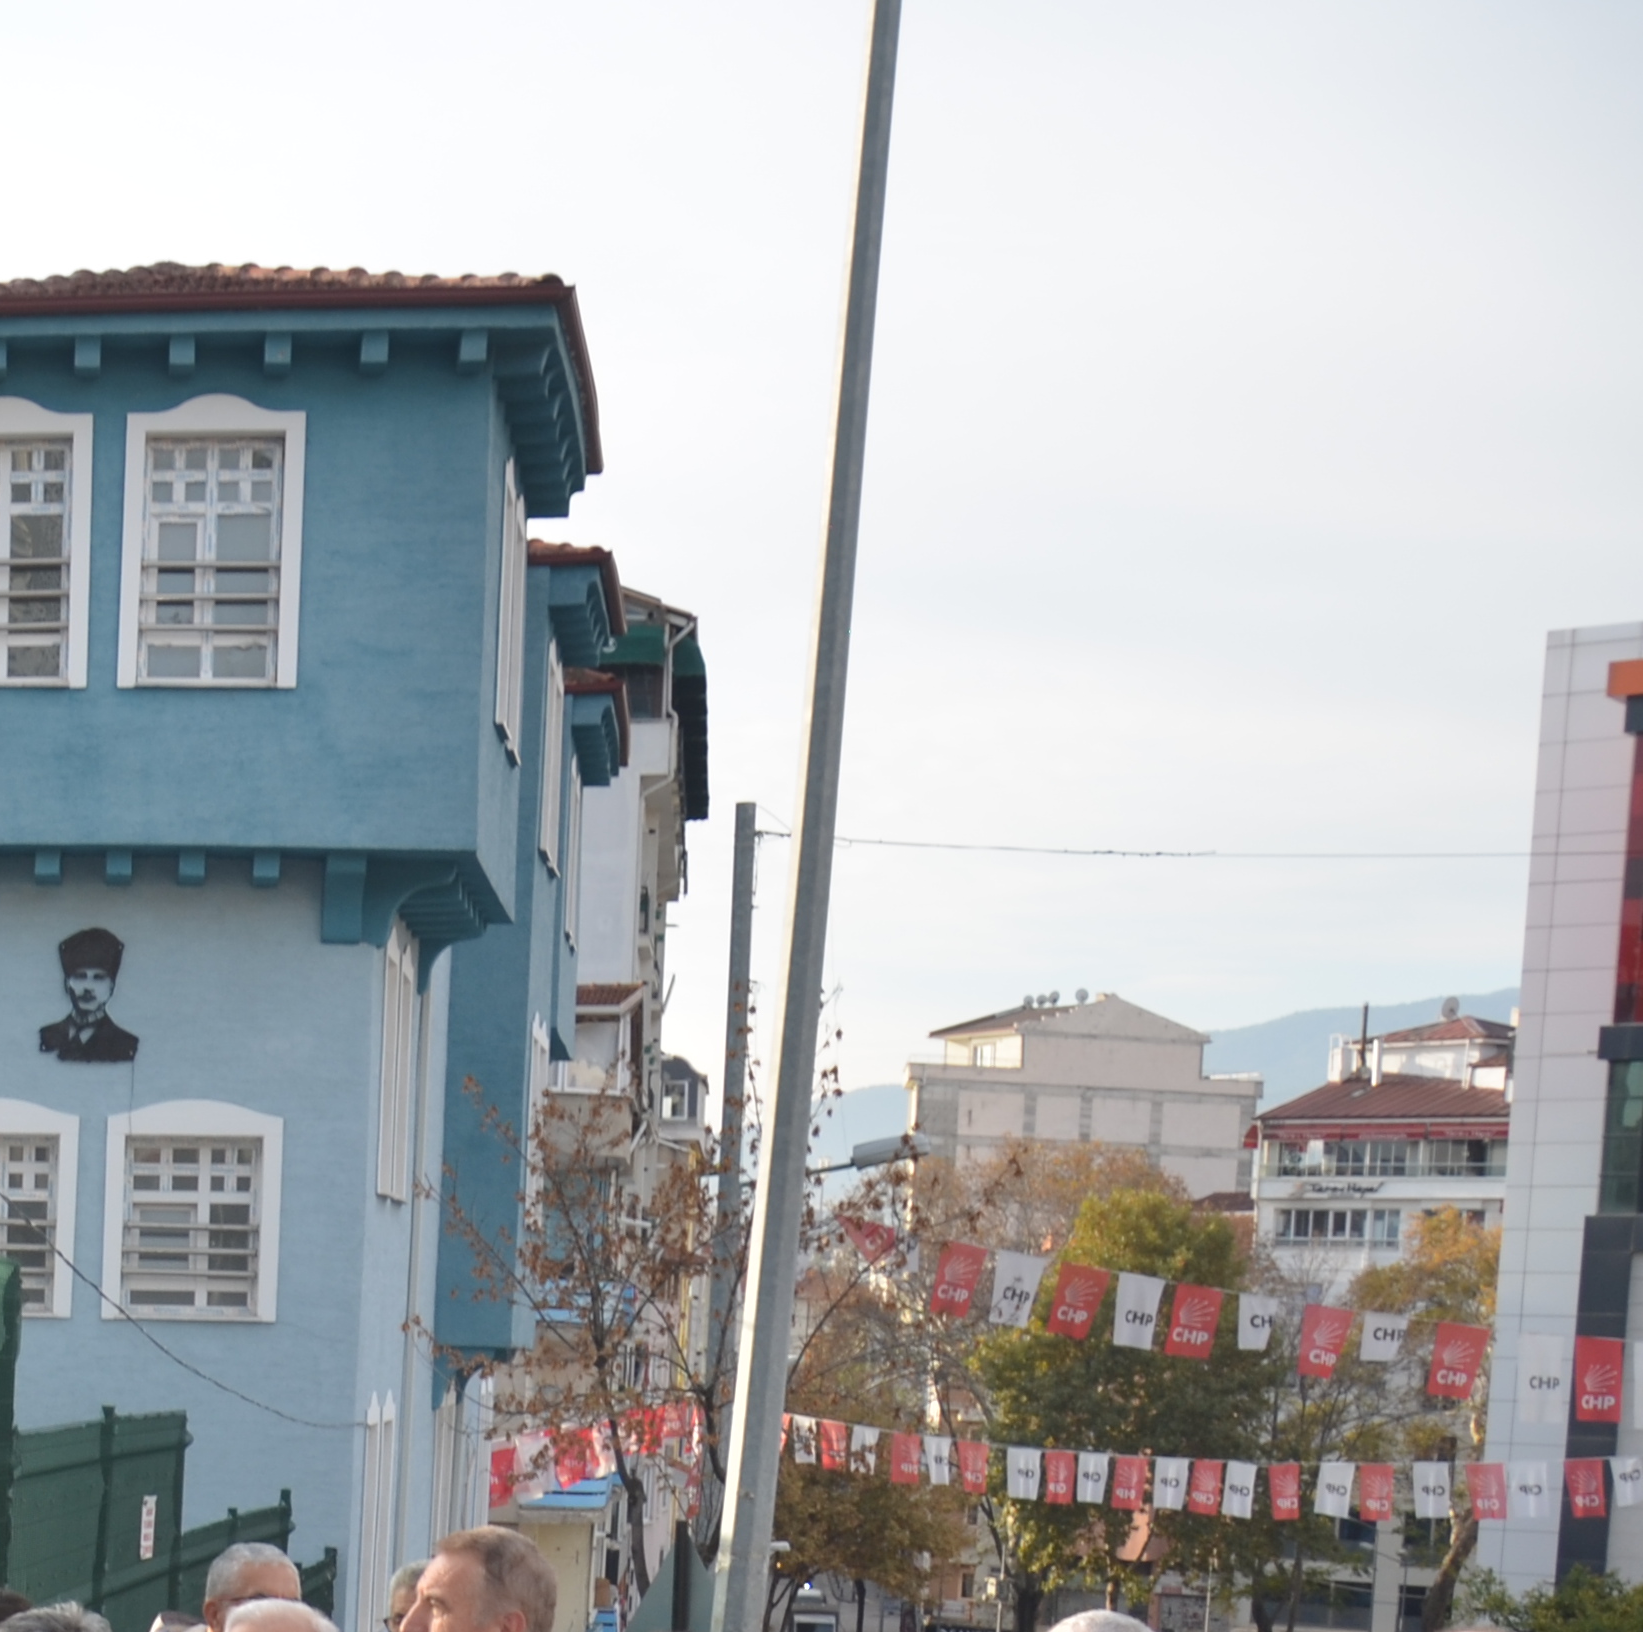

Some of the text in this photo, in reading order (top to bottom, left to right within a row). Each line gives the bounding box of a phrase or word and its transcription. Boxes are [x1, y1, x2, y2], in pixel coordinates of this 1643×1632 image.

[937, 1284, 969, 1303] CHP
[1002, 1286, 1031, 1304] CHP
[1057, 1305, 1088, 1325] CHP
[1125, 1309, 1153, 1327] CHP
[1249, 1314, 1274, 1329] CH
[1172, 1326, 1209, 1345] CHP
[1309, 1348, 1337, 1367] CHP
[1436, 1369, 1468, 1387] CHP
[1529, 1375, 1560, 1390] CHP
[1581, 1393, 1616, 1411] CHP
